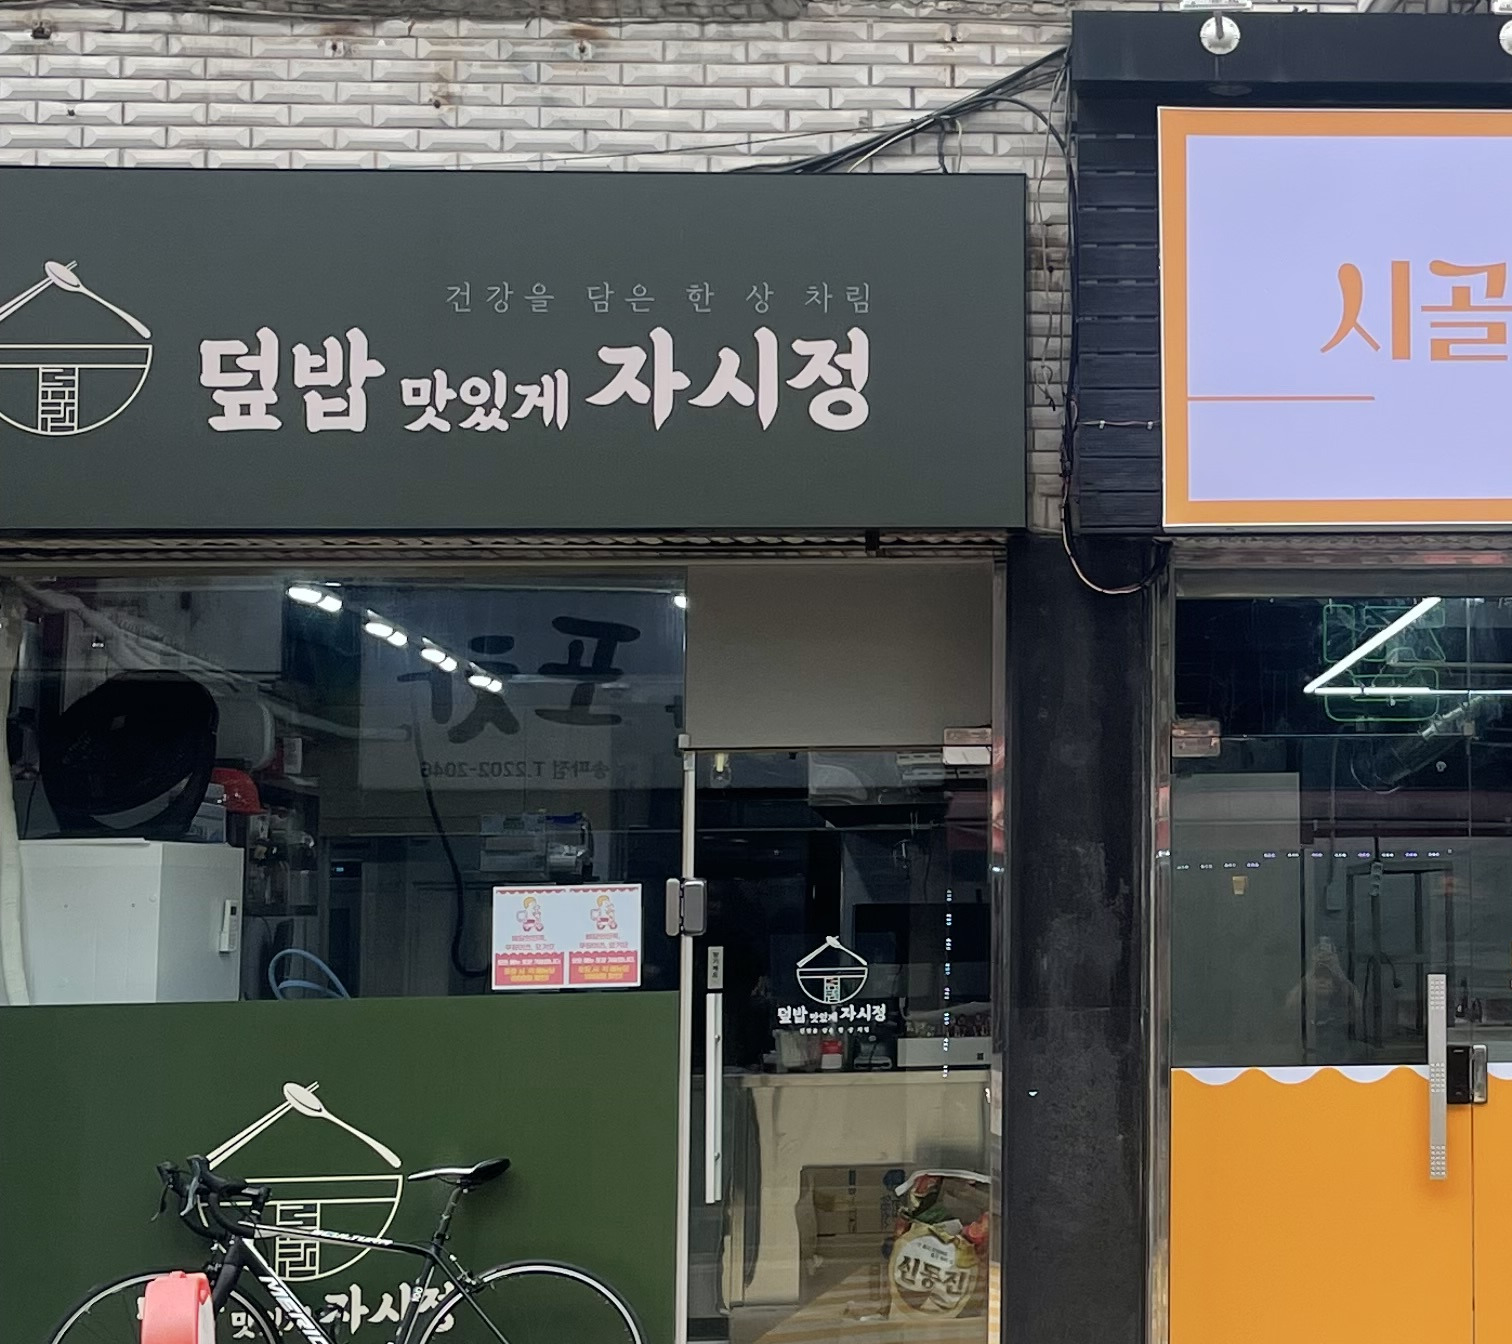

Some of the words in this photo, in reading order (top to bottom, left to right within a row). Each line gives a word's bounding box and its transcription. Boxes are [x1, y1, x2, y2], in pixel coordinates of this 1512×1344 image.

[446, 281, 556, 315] 건강을
[587, 281, 656, 315] 담은
[685, 281, 716, 315] 한
[746, 281, 775, 315] 상
[804, 281, 871, 315] 차림
[199, 326, 387, 434] 덮밥
[400, 368, 570, 434] 맛있게
[585, 326, 870, 433] 자시정
[777, 1004, 809, 1025] 덮밥
[840, 1003, 887, 1022] 자시정
[897, 1255, 967, 1295] 신동진
